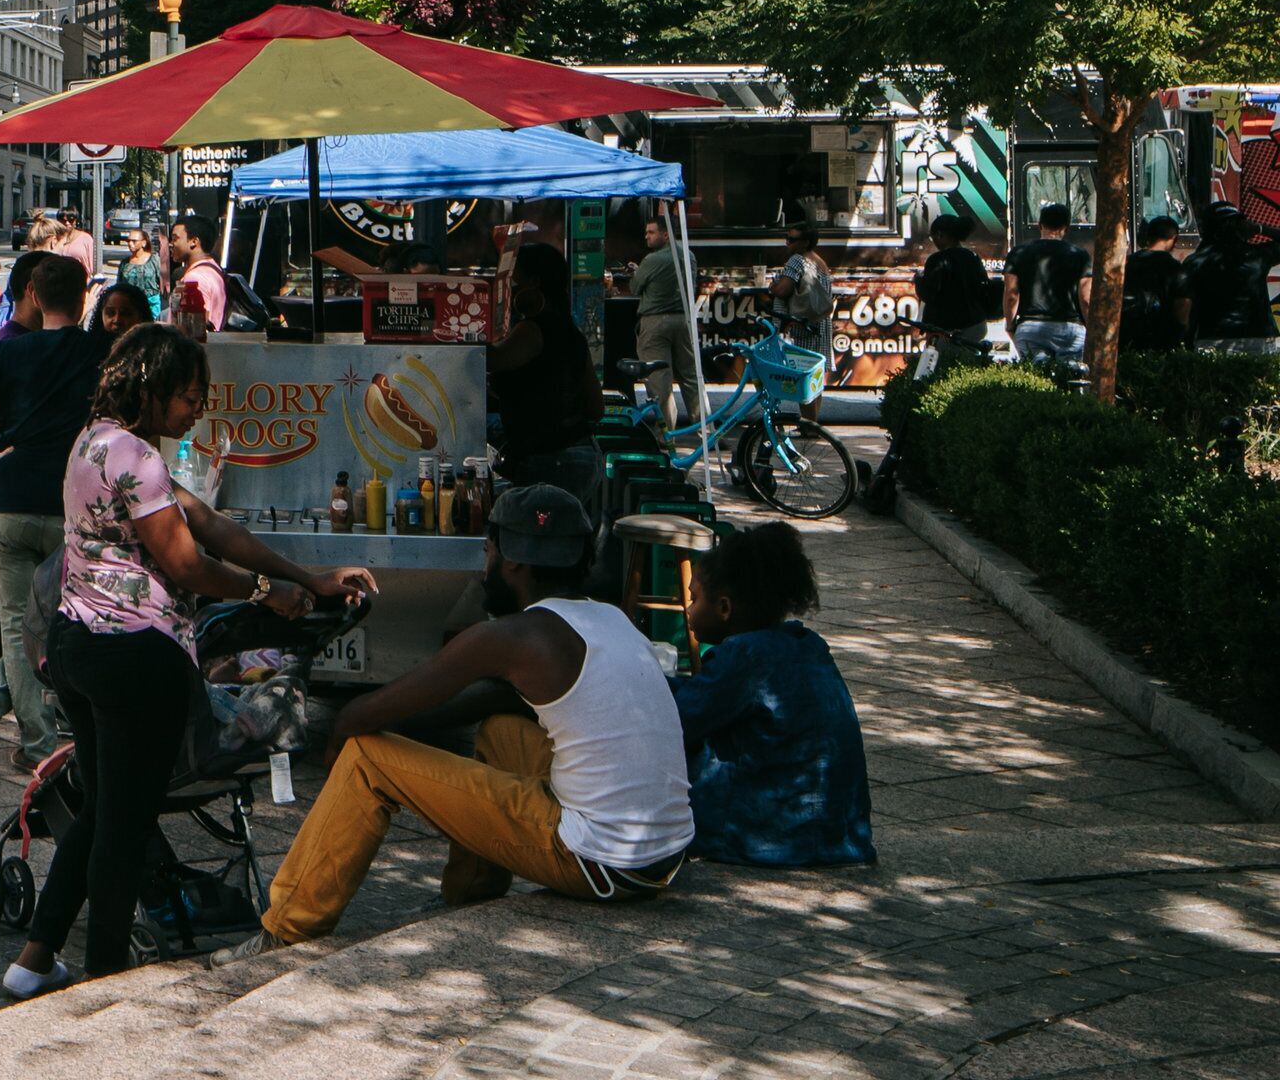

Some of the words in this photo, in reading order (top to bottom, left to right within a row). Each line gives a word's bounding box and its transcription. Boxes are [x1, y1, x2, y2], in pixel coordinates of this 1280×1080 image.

[182, 145, 249, 161] Authentic
[182, 160, 250, 175] Caribbe
[182, 173, 229, 189] Dishes
[377, 305, 429, 319] TORTILLA
[387, 315, 420, 326] CHIPS
[202, 382, 336, 414] GLORY
[208, 418, 319, 449] DOGS
